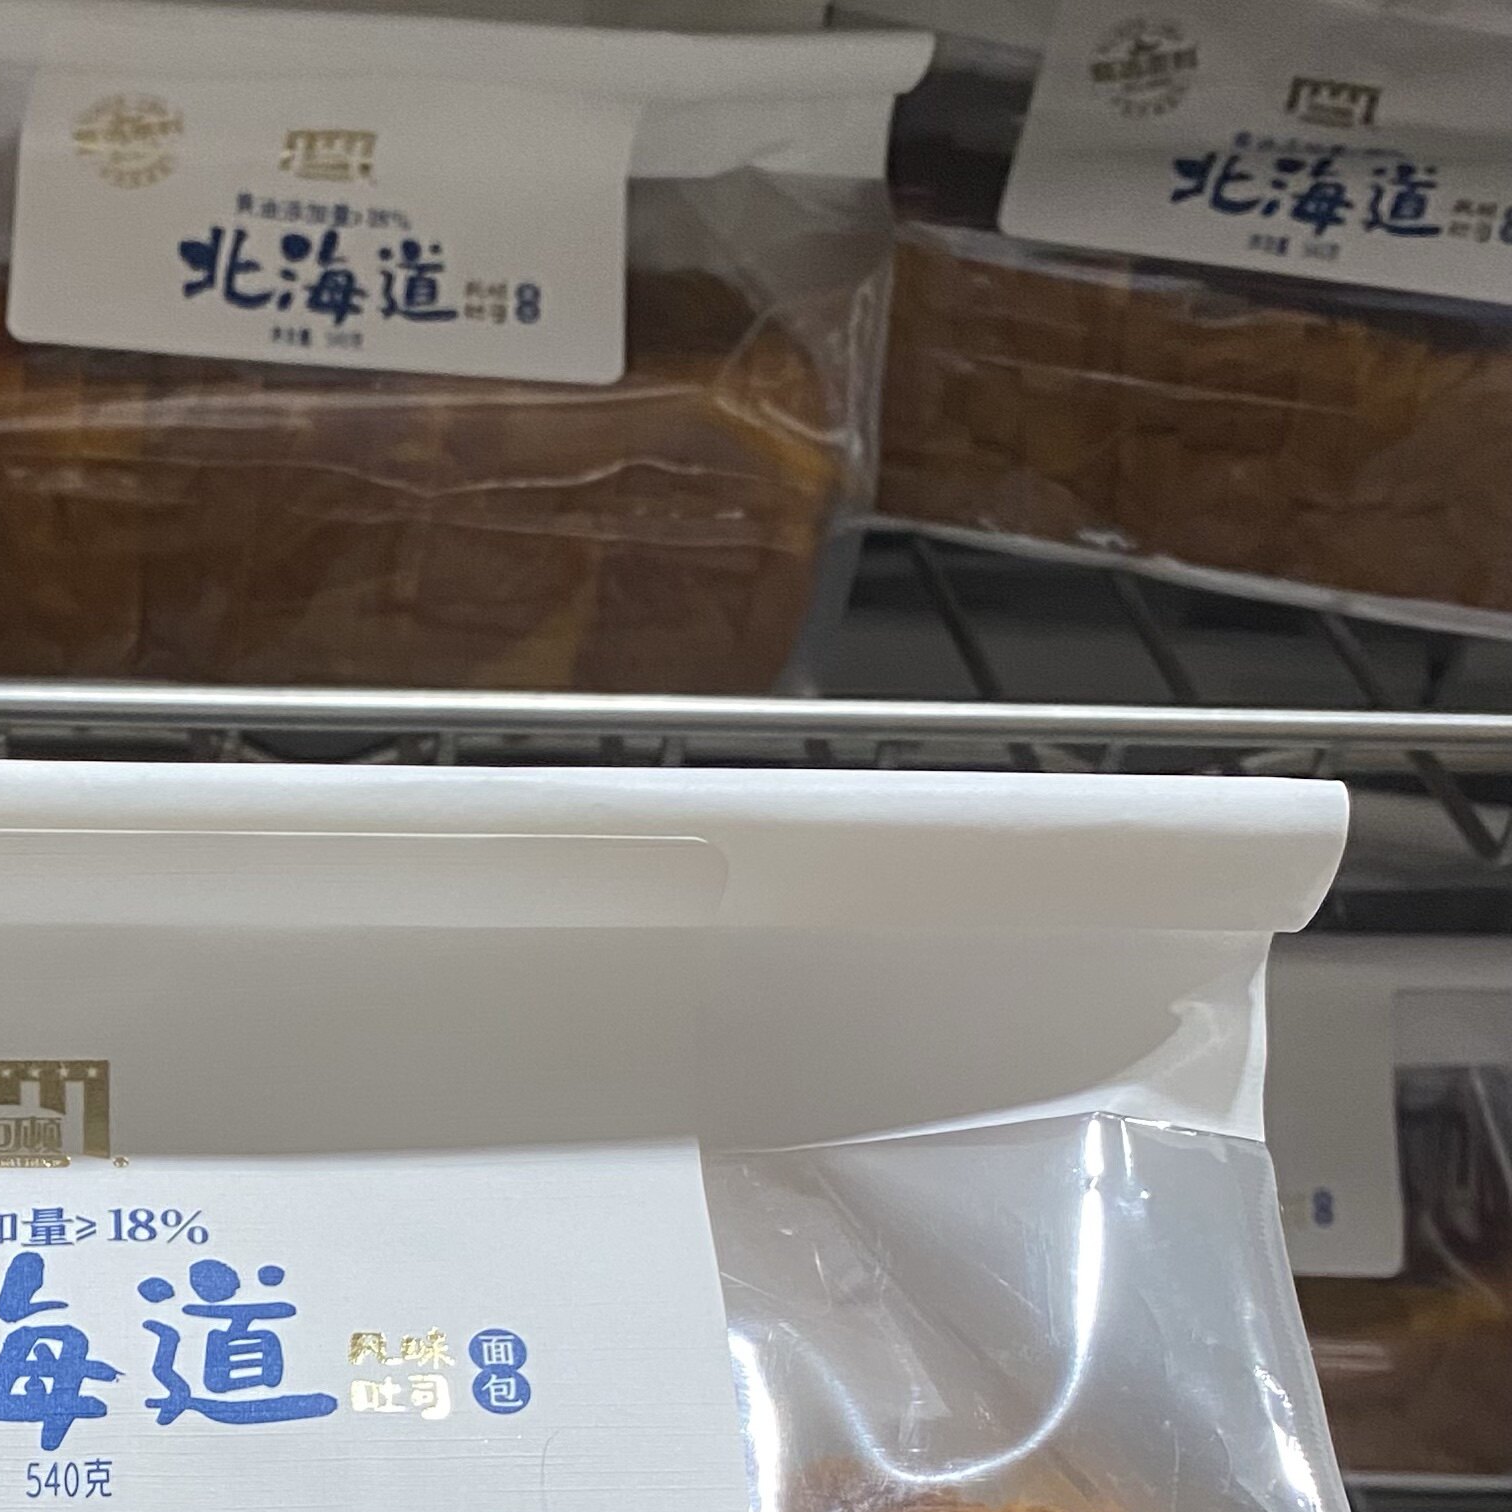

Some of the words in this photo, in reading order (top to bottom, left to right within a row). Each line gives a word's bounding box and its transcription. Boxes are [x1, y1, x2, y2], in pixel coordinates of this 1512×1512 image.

[1170, 151, 1441, 236] 北海道
[178, 226, 459, 325] 北海道
[350, 1372, 452, 1420] 吐司
[476, 1332, 526, 1410] 面包
